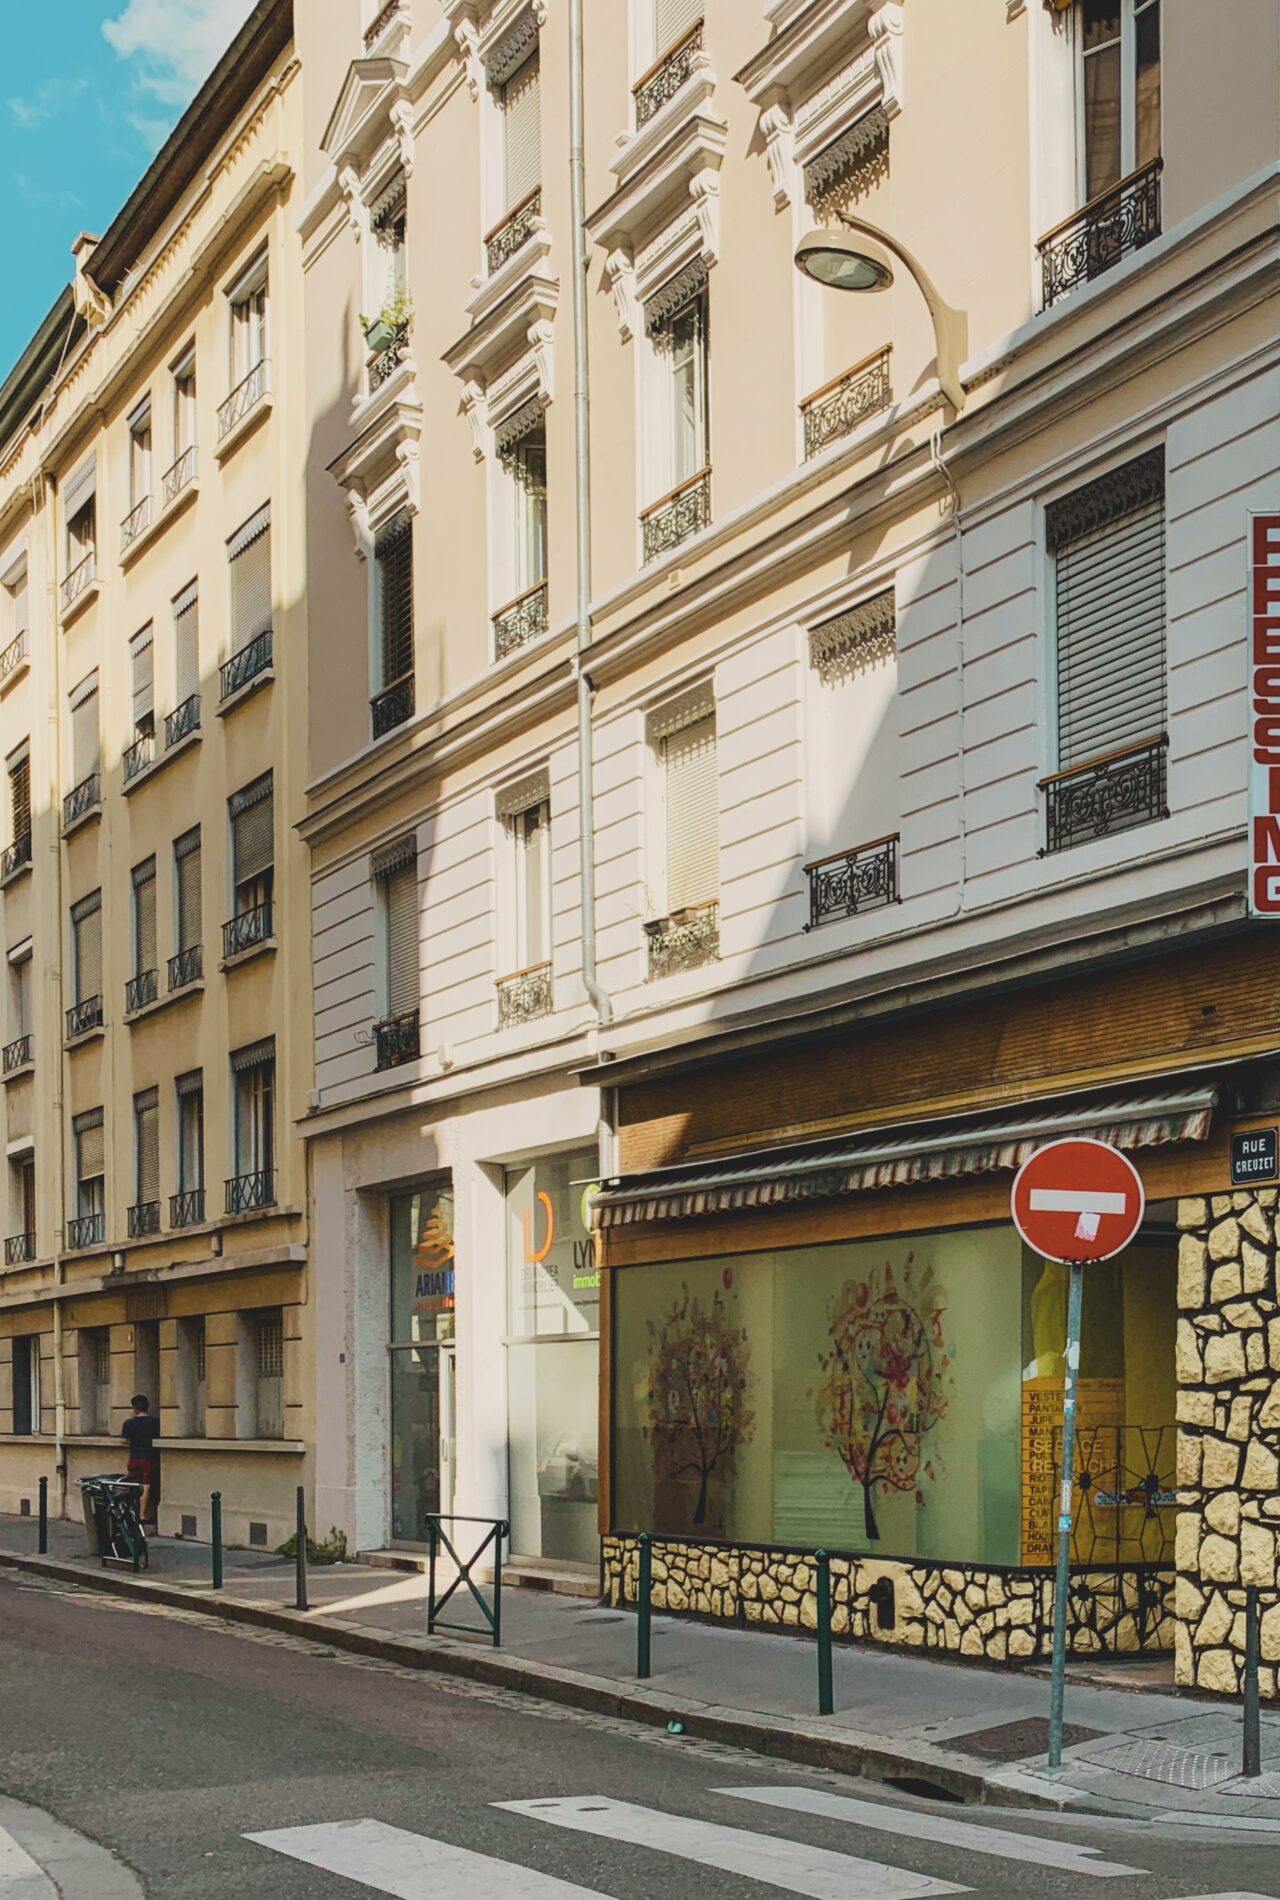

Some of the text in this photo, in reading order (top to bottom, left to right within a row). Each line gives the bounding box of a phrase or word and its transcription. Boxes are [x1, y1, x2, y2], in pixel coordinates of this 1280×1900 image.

[1242, 1139, 1266, 1154] RUE
[1235, 1156, 1274, 1173] CREUZET
[1029, 1415, 1056, 1425] JUPE
